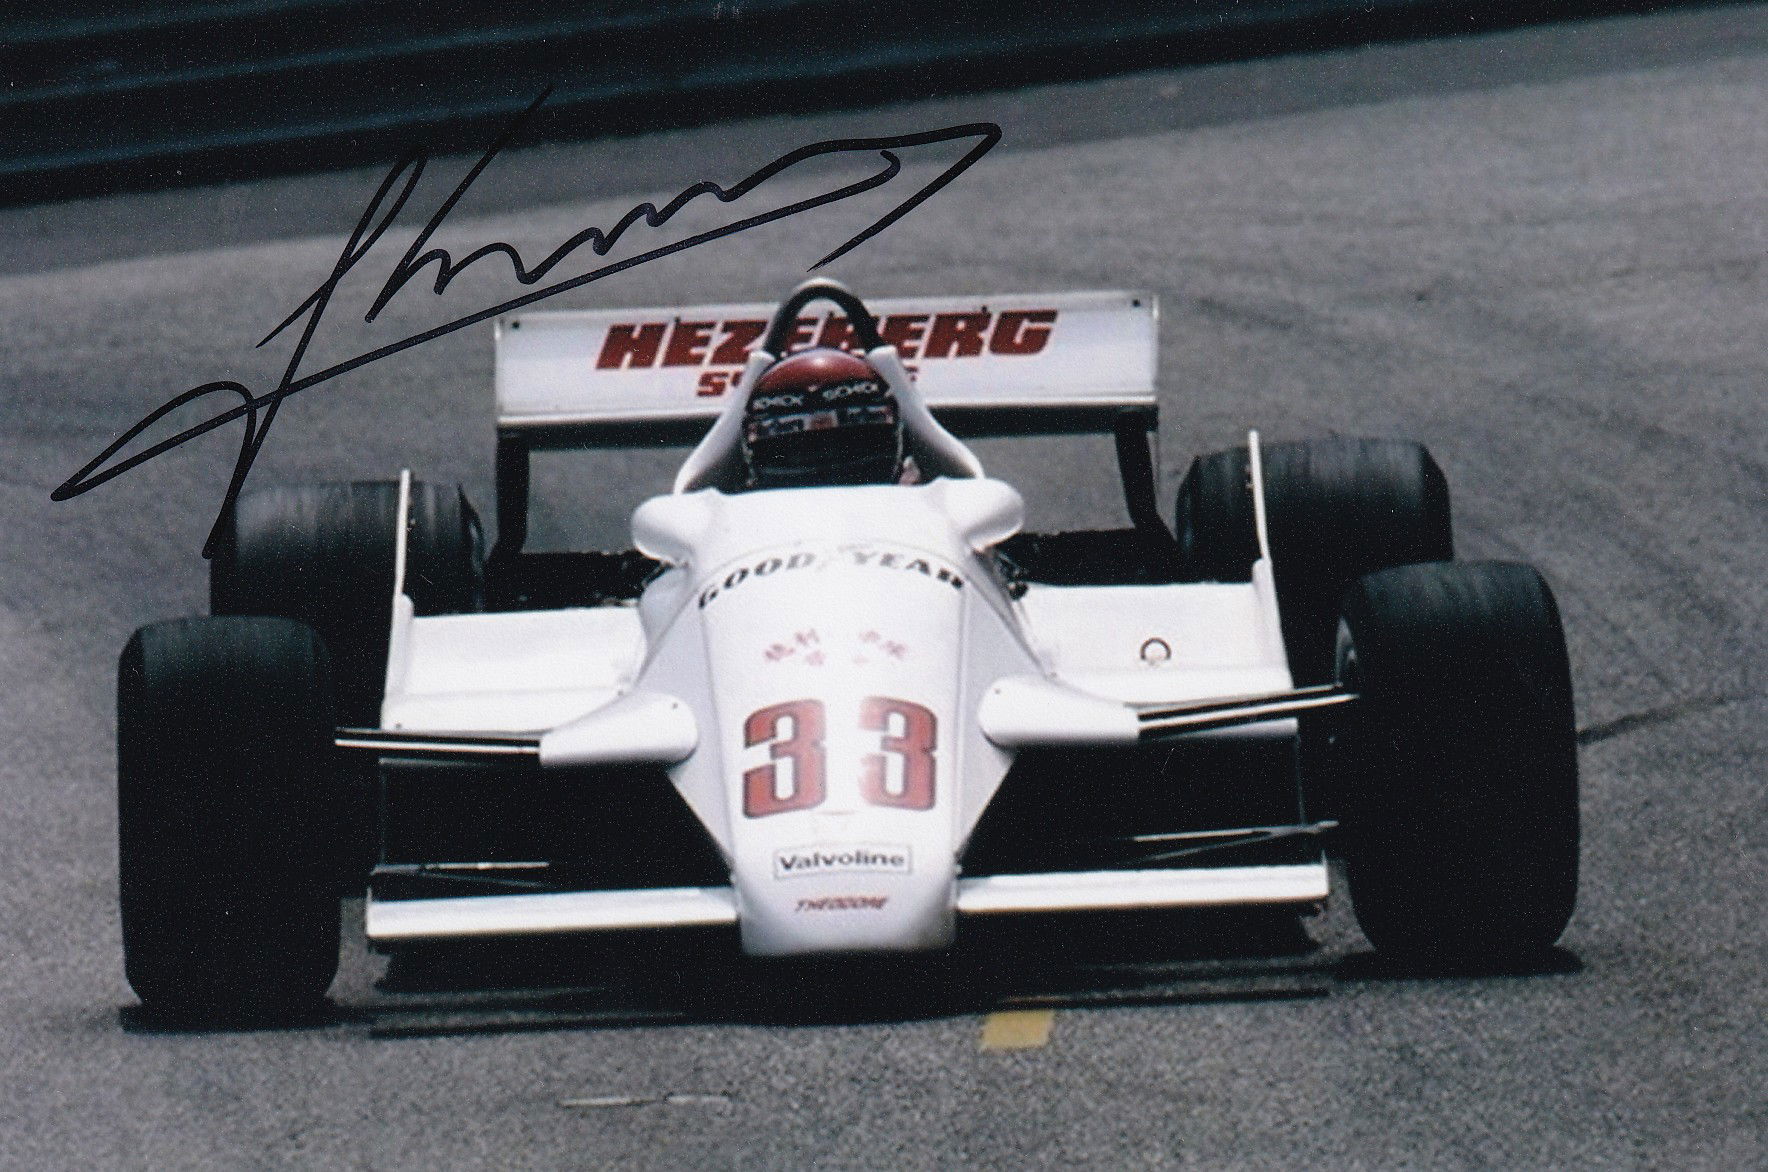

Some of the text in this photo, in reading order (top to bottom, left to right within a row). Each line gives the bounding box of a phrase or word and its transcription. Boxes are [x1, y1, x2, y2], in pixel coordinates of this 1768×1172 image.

[698, 551, 965, 610] GOOD YEAR
[780, 848, 905, 871] Valvoline
